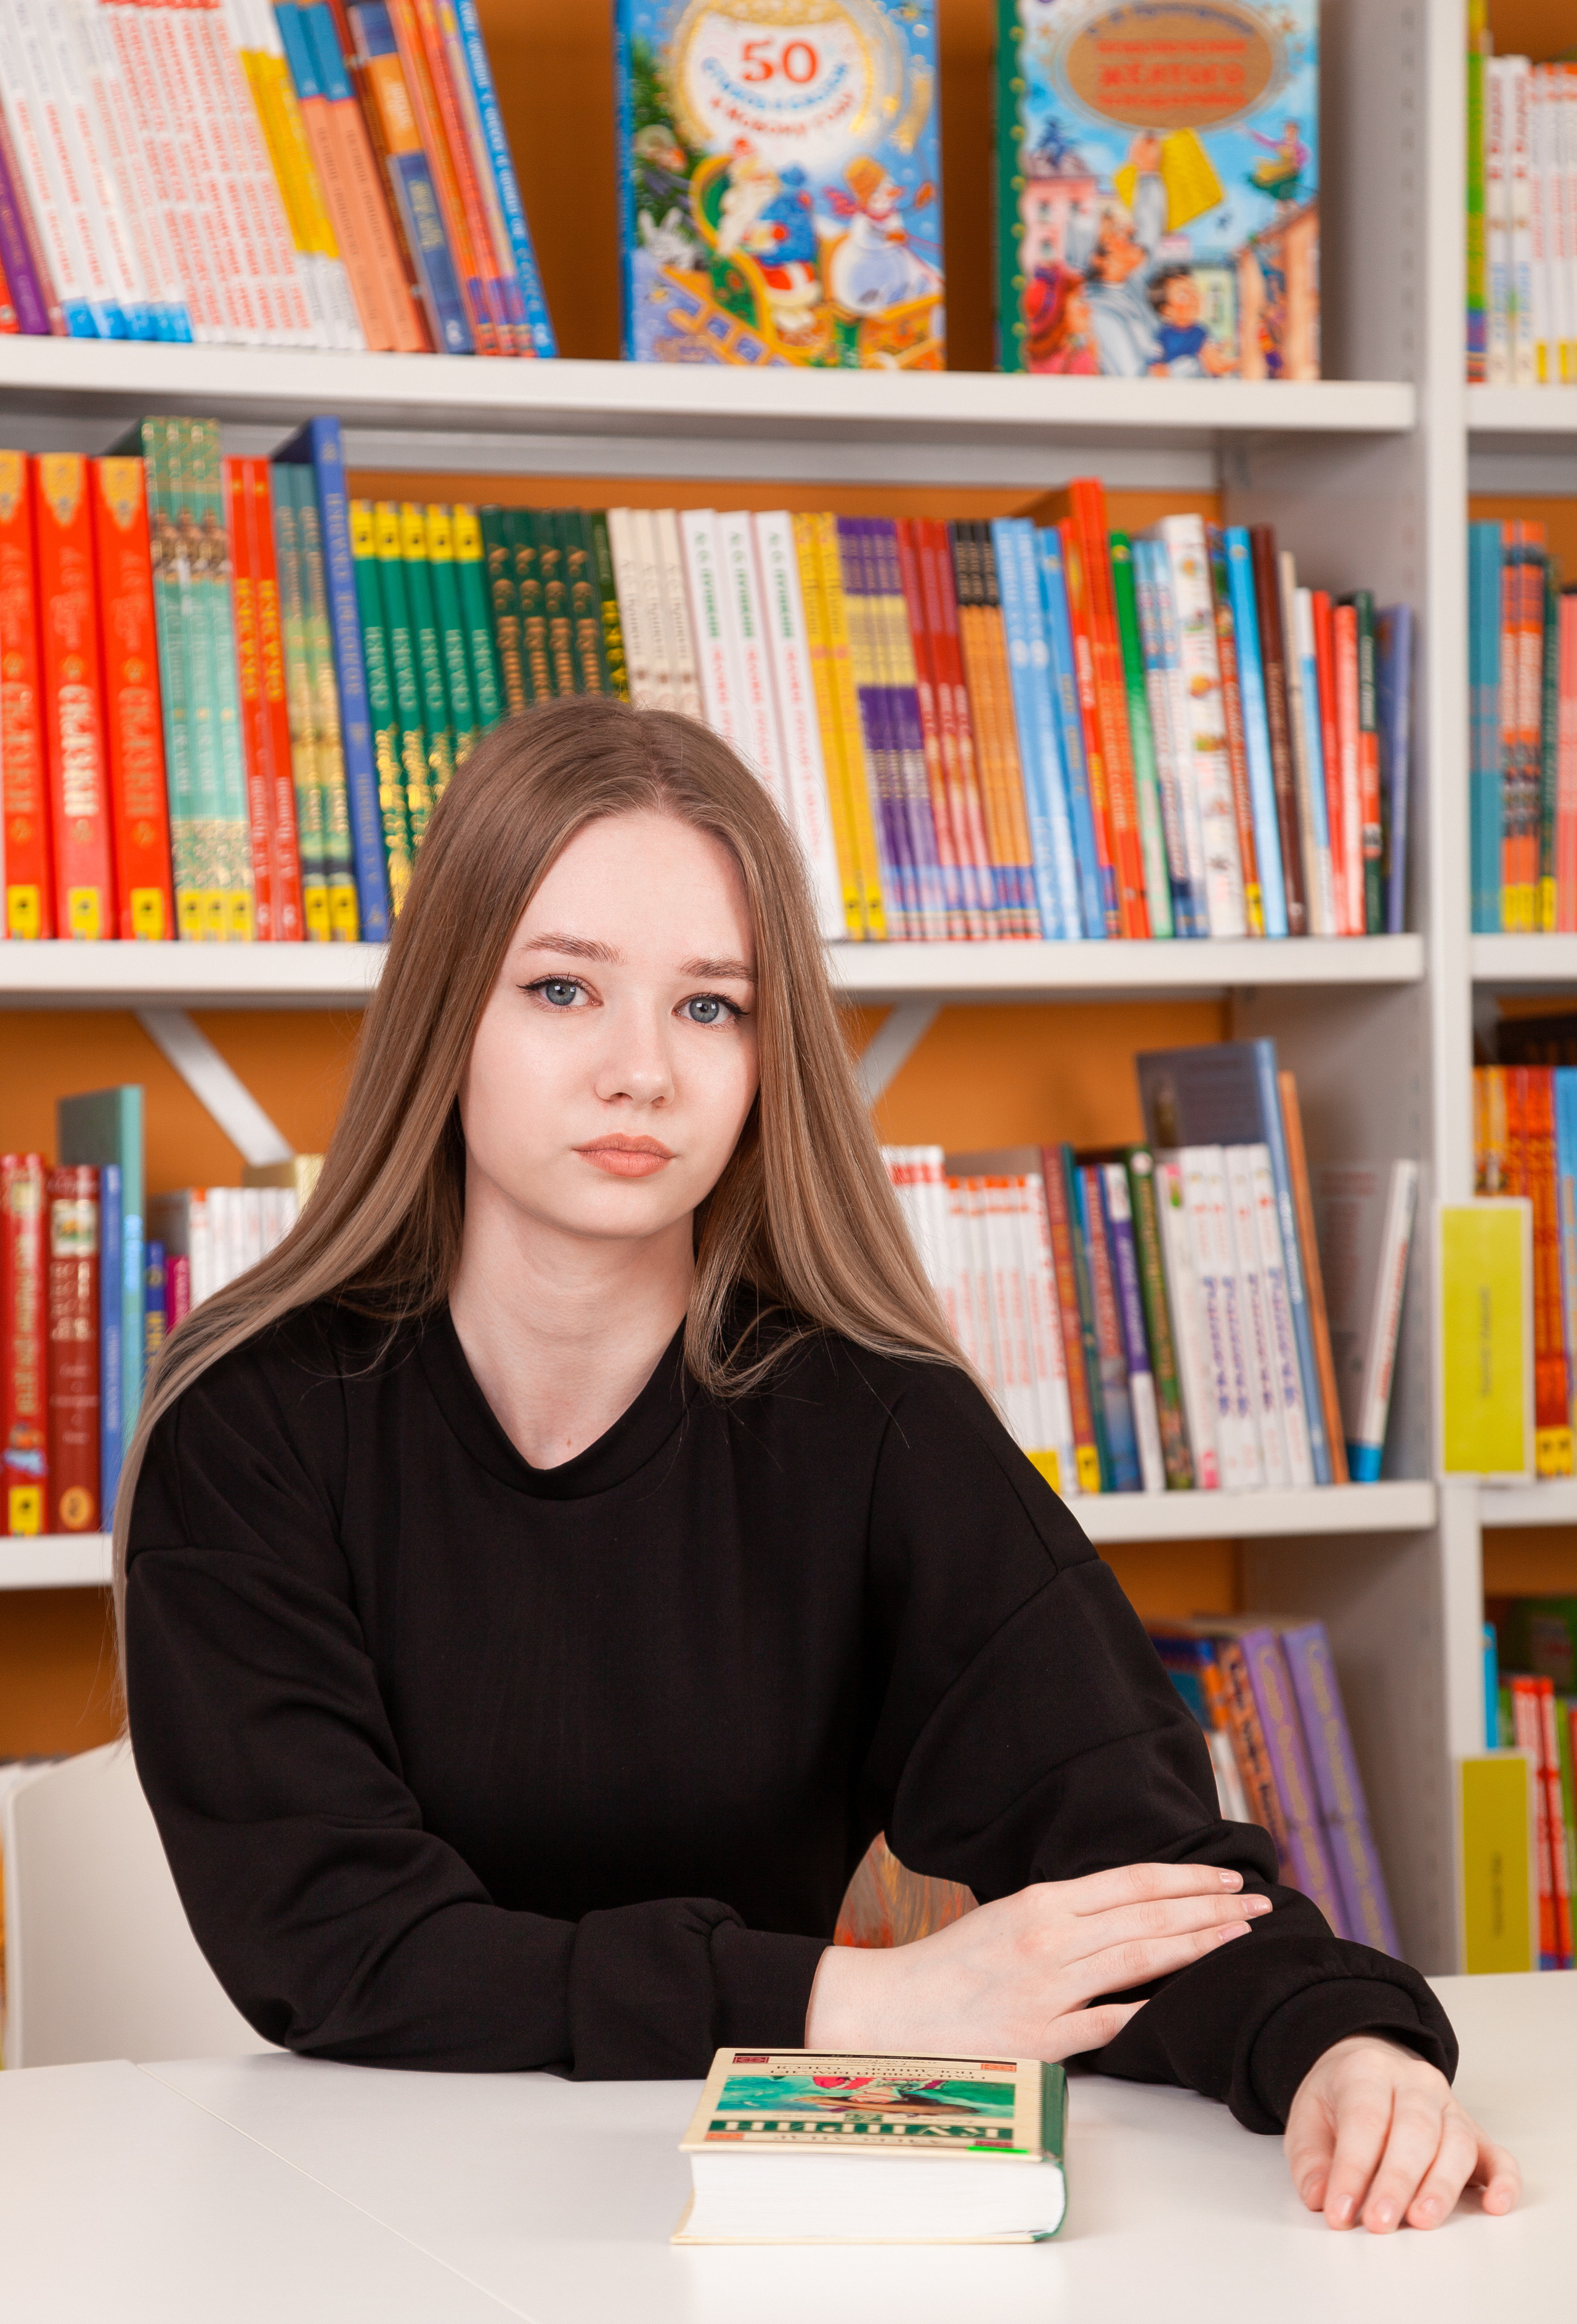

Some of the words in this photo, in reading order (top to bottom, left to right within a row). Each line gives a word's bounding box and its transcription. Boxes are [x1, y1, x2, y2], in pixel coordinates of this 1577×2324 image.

[740, 36, 820, 85] 50
[365, 626, 389, 710] СКАЗКИ
[392, 628, 417, 711] СКАЗКИ
[419, 628, 445, 712] СКАЗКИ
[445, 629, 471, 713] СКАЗКИ
[472, 629, 500, 715] СКАЗКИ
[857, 2070, 986, 2079] ГРАНАТОВЫЙ
[723, 2120, 1000, 2139] КУПРИН
